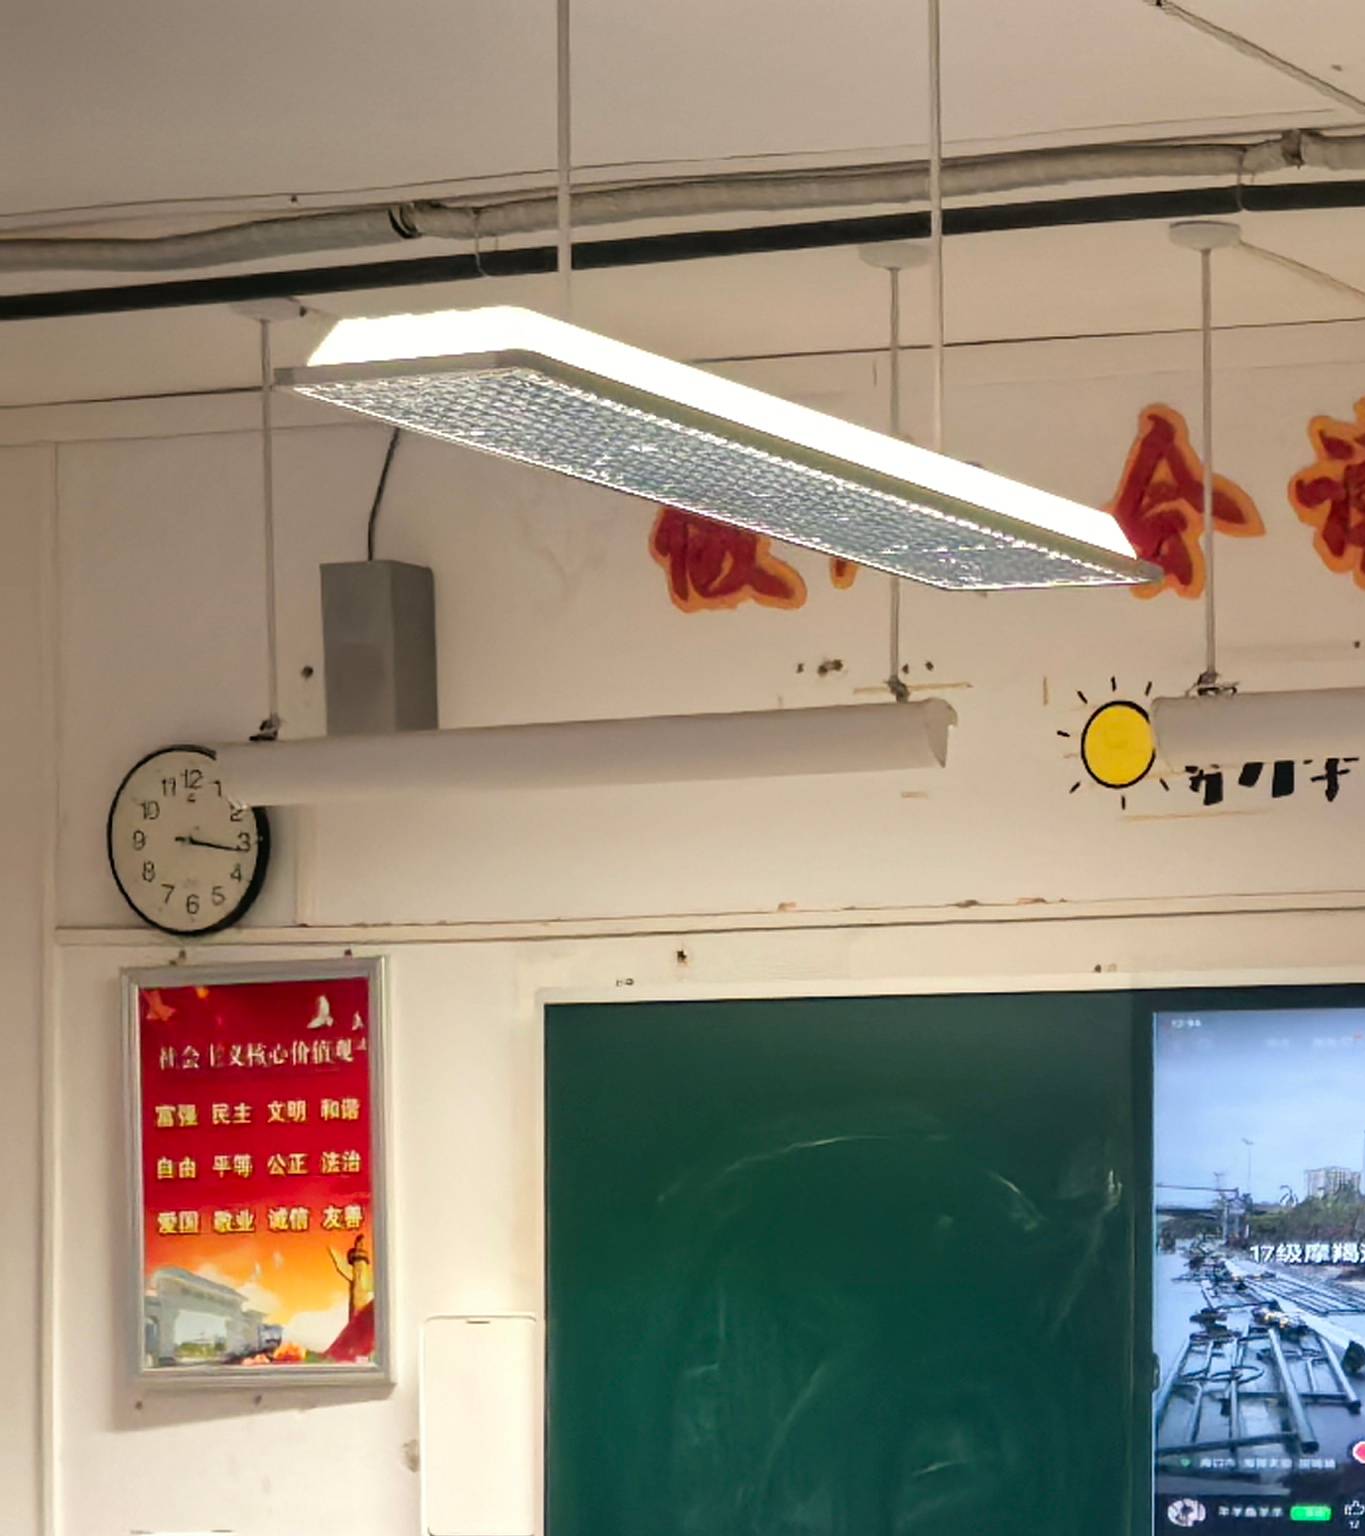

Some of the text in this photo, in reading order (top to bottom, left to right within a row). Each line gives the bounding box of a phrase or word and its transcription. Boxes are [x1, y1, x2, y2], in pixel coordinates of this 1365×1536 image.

[161, 777, 176, 796] 11
[180, 769, 203, 789] 12
[212, 780, 222, 797] 1
[141, 801, 160, 820] 10
[132, 830, 146, 851] 9
[237, 833, 251, 852] 3
[142, 861, 156, 882] 8
[230, 863, 242, 882] 4
[161, 884, 175, 904] 7
[212, 886, 226, 905] 5
[186, 895, 199, 914] 6
[155, 1098, 360, 1127] 富强 民主 文明 和谐
[157, 1151, 361, 1179] 自由 平等 公正 法治
[157, 1205, 363, 1234] 爱国 敬业 诚信 友善
